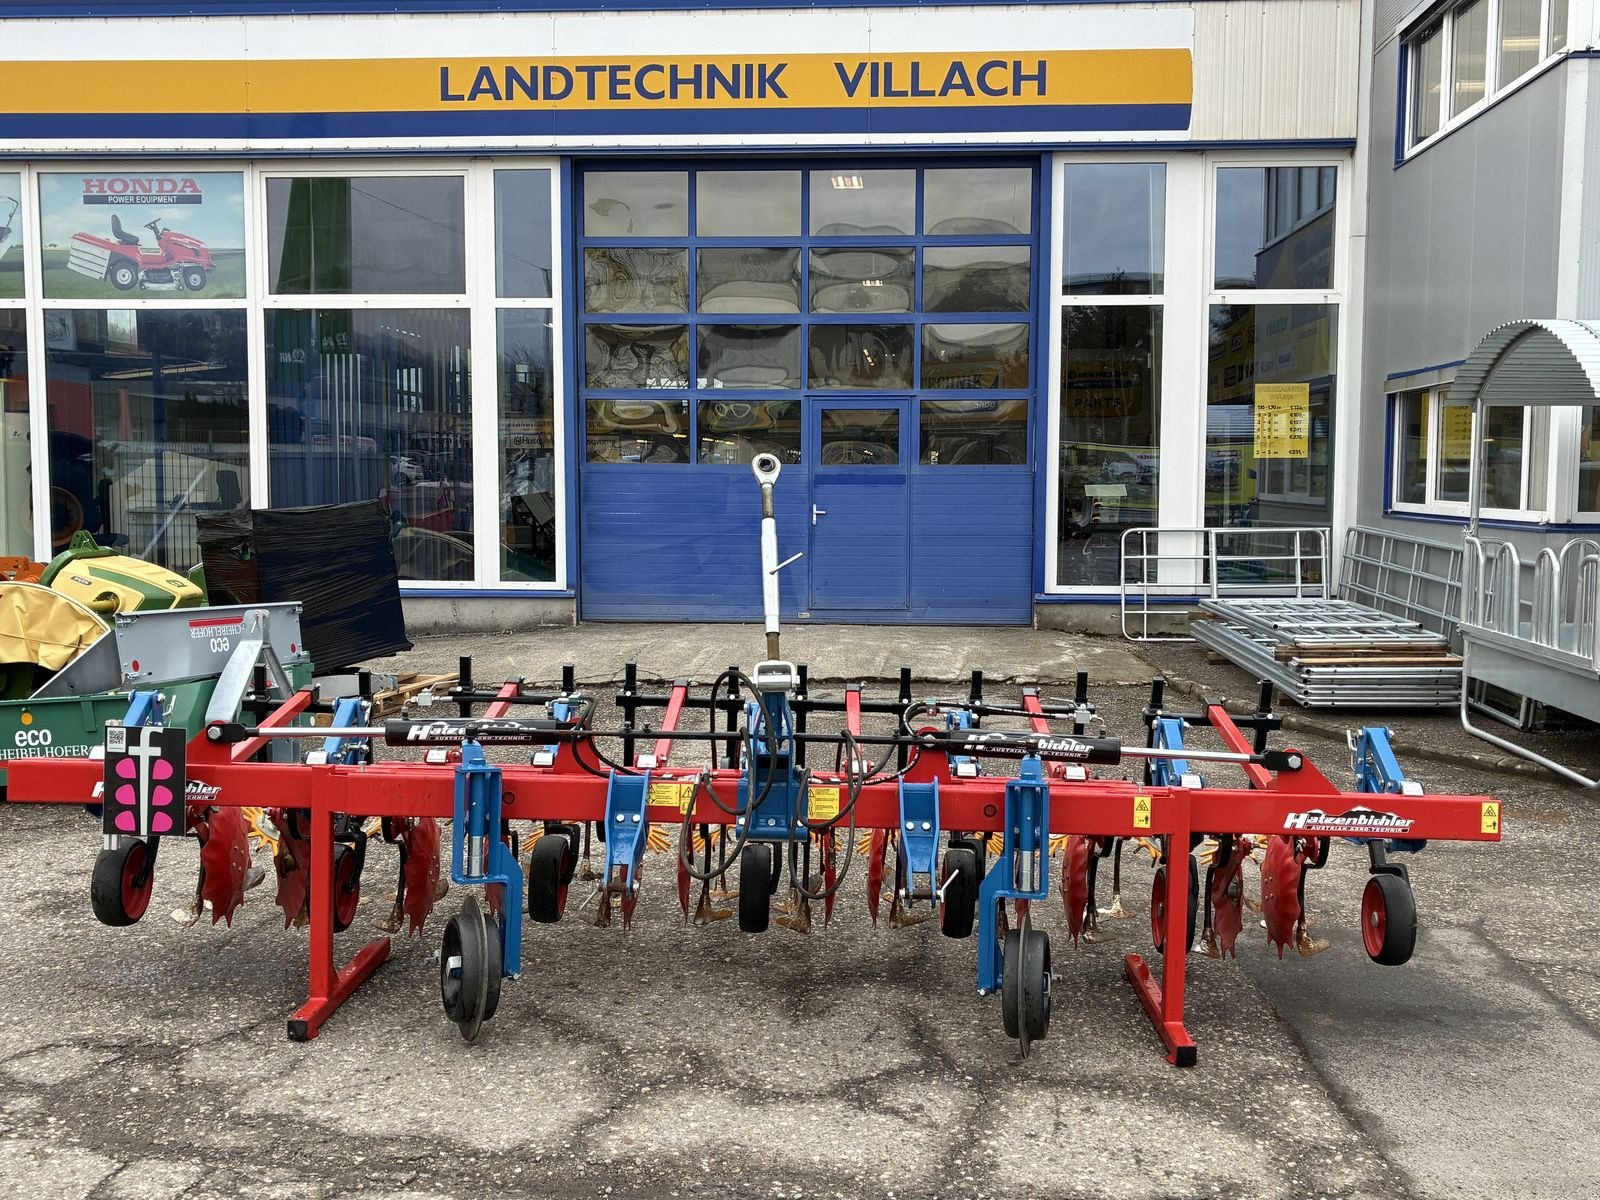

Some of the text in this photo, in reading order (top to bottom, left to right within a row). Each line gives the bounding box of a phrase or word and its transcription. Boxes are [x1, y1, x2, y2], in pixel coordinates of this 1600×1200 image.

[440, 60, 1047, 102] LANDTECHNIK VILLACH
[82, 178, 202, 193] HONDA
[108, 195, 178, 204] POWER EQUIPMENT
[190, 624, 245, 639] CHEIBELHOFER
[210, 637, 230, 653] eco
[15, 729, 52, 747] eco
[1283, 813, 1415, 830] Hatzenbichler
